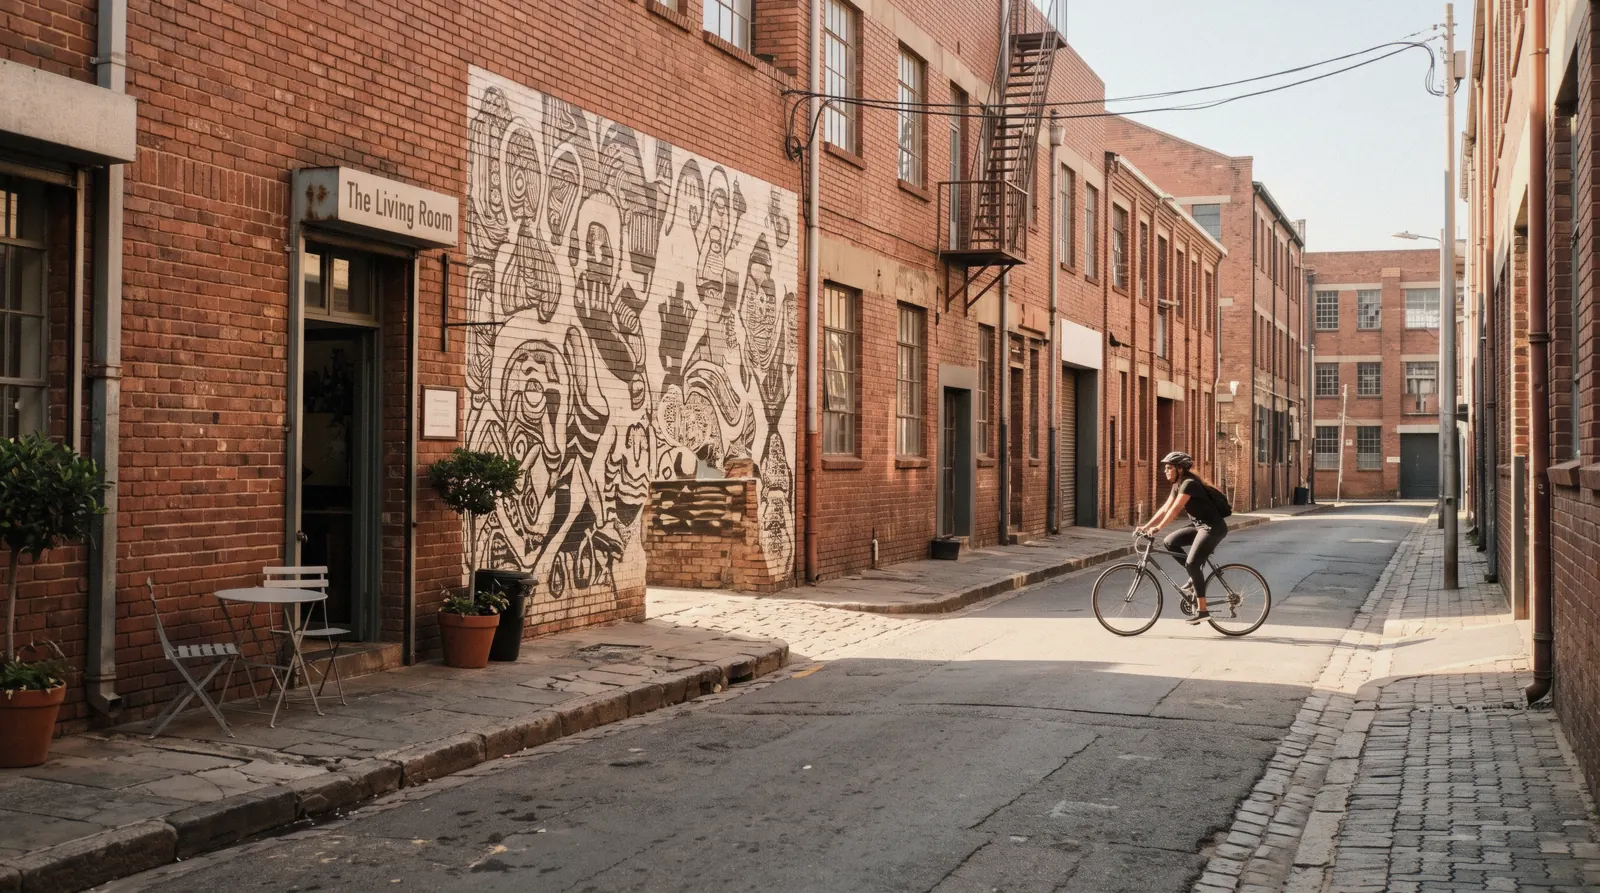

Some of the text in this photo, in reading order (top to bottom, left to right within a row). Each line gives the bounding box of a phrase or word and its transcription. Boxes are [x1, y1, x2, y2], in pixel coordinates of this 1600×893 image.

[347, 181, 452, 232] The Living Room
